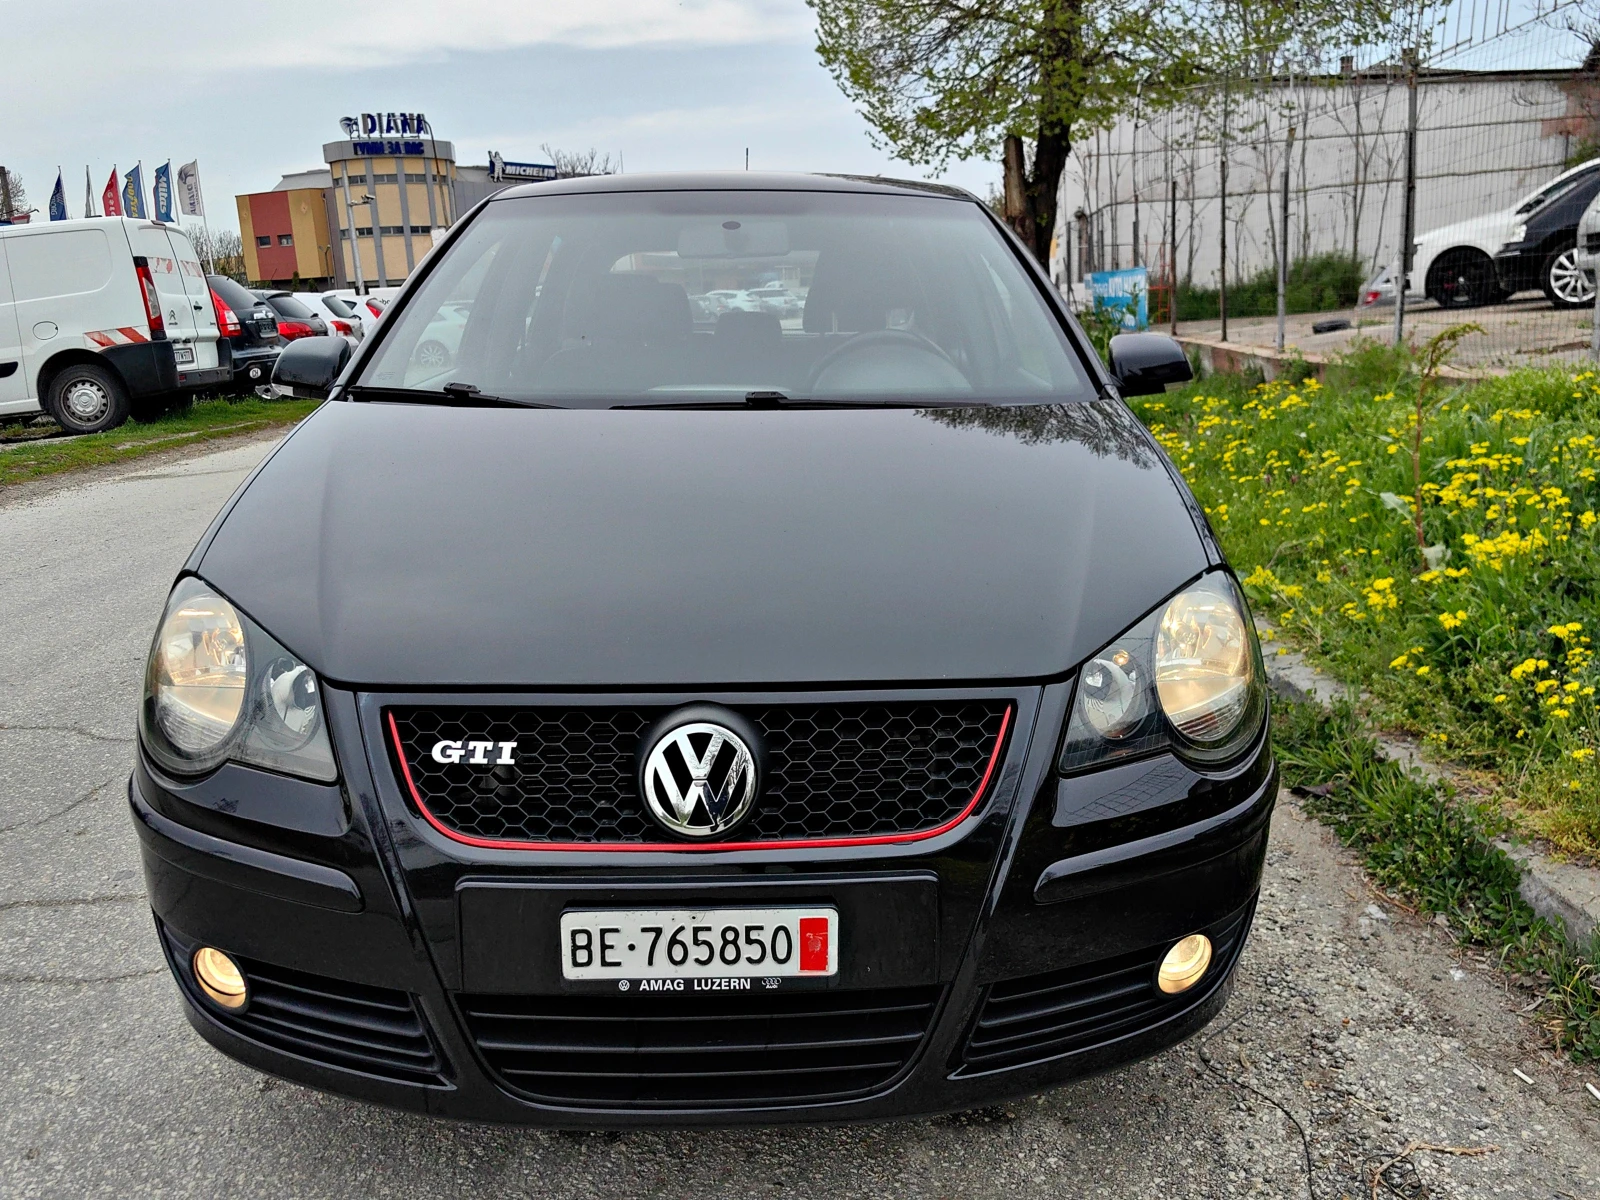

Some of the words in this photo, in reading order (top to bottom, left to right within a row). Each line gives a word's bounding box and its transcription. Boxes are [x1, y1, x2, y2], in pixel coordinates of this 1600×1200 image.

[361, 112, 429, 135] DIANA
[505, 165, 556, 178] MICHELIN
[158, 173, 167, 214] Mitas
[431, 739, 518, 765] GTI
[639, 978, 685, 992] AMAG
[694, 977, 751, 990] LUZERN
